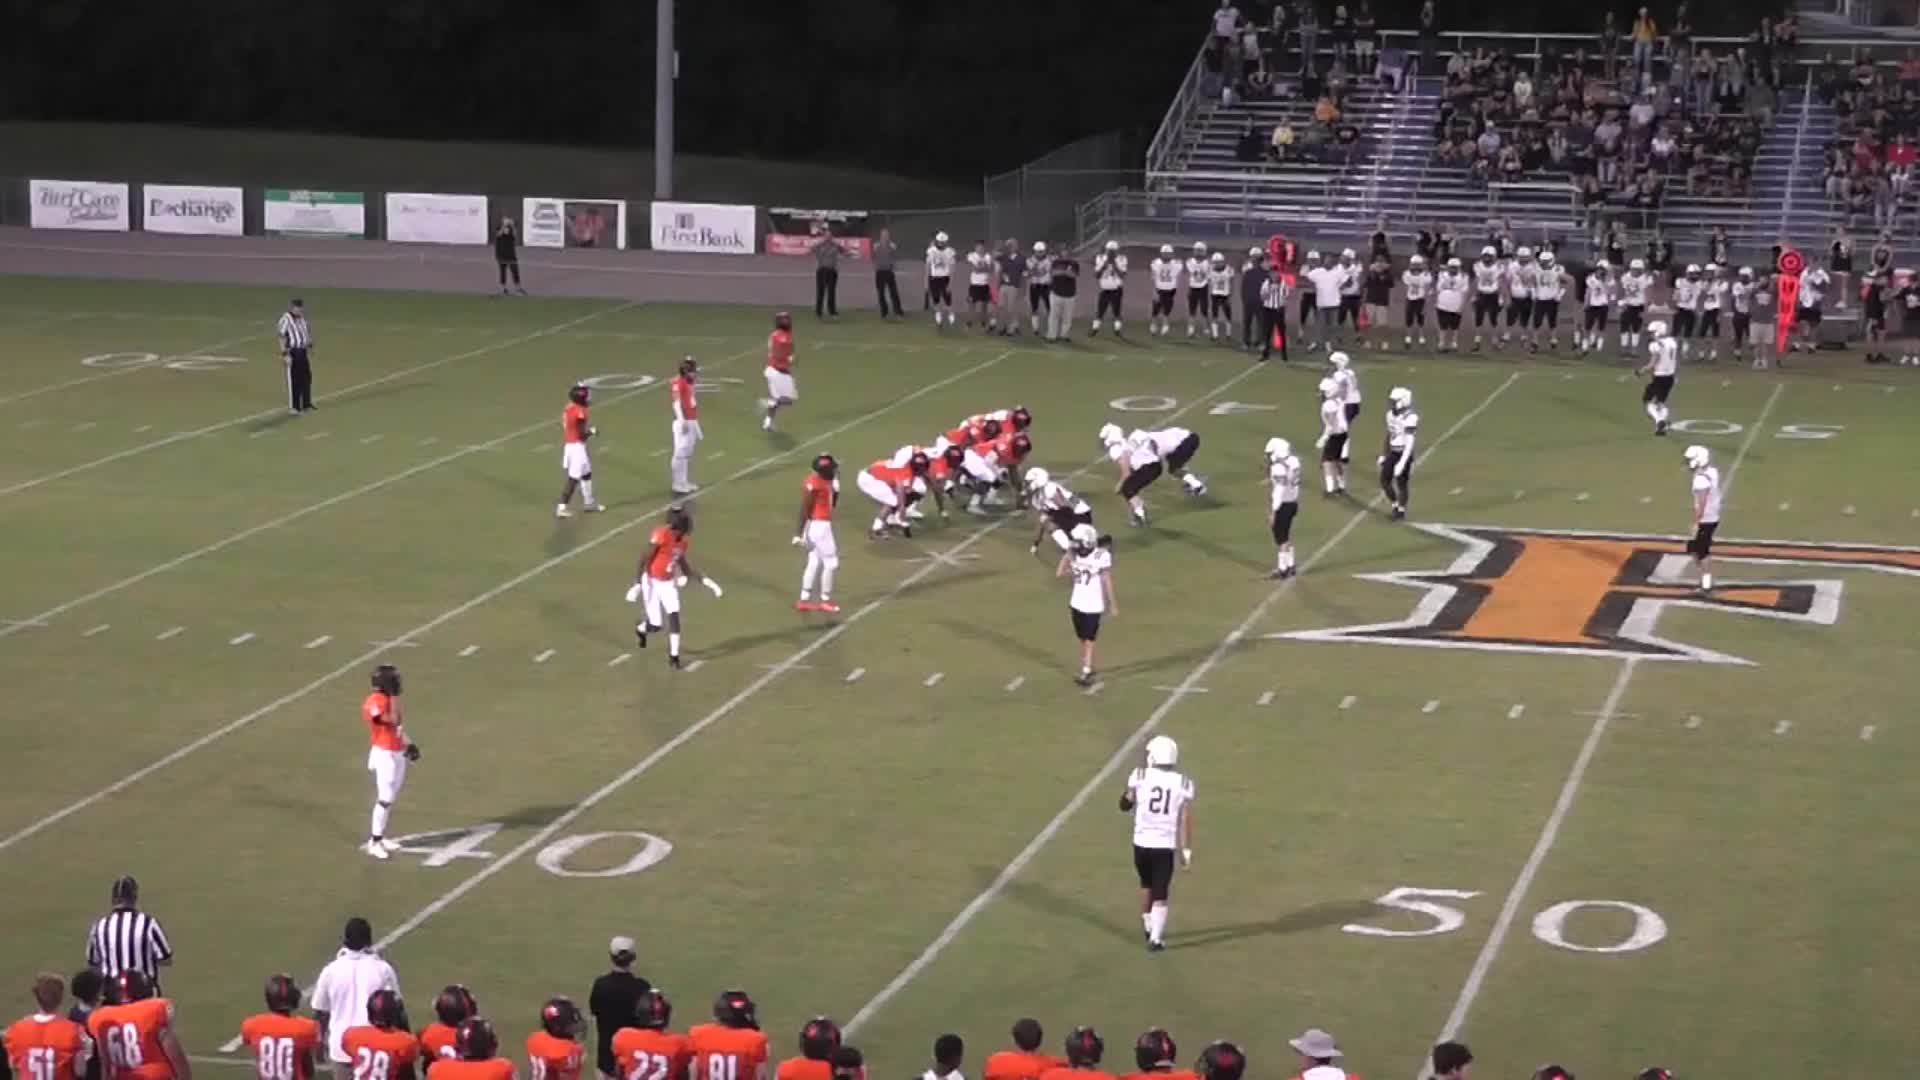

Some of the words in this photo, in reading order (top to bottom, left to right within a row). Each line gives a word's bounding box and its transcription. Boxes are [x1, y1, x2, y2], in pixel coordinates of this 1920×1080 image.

[1148, 785, 1172, 816] 21
[106, 1022, 143, 1069] 68
[259, 1035, 295, 1079] 80
